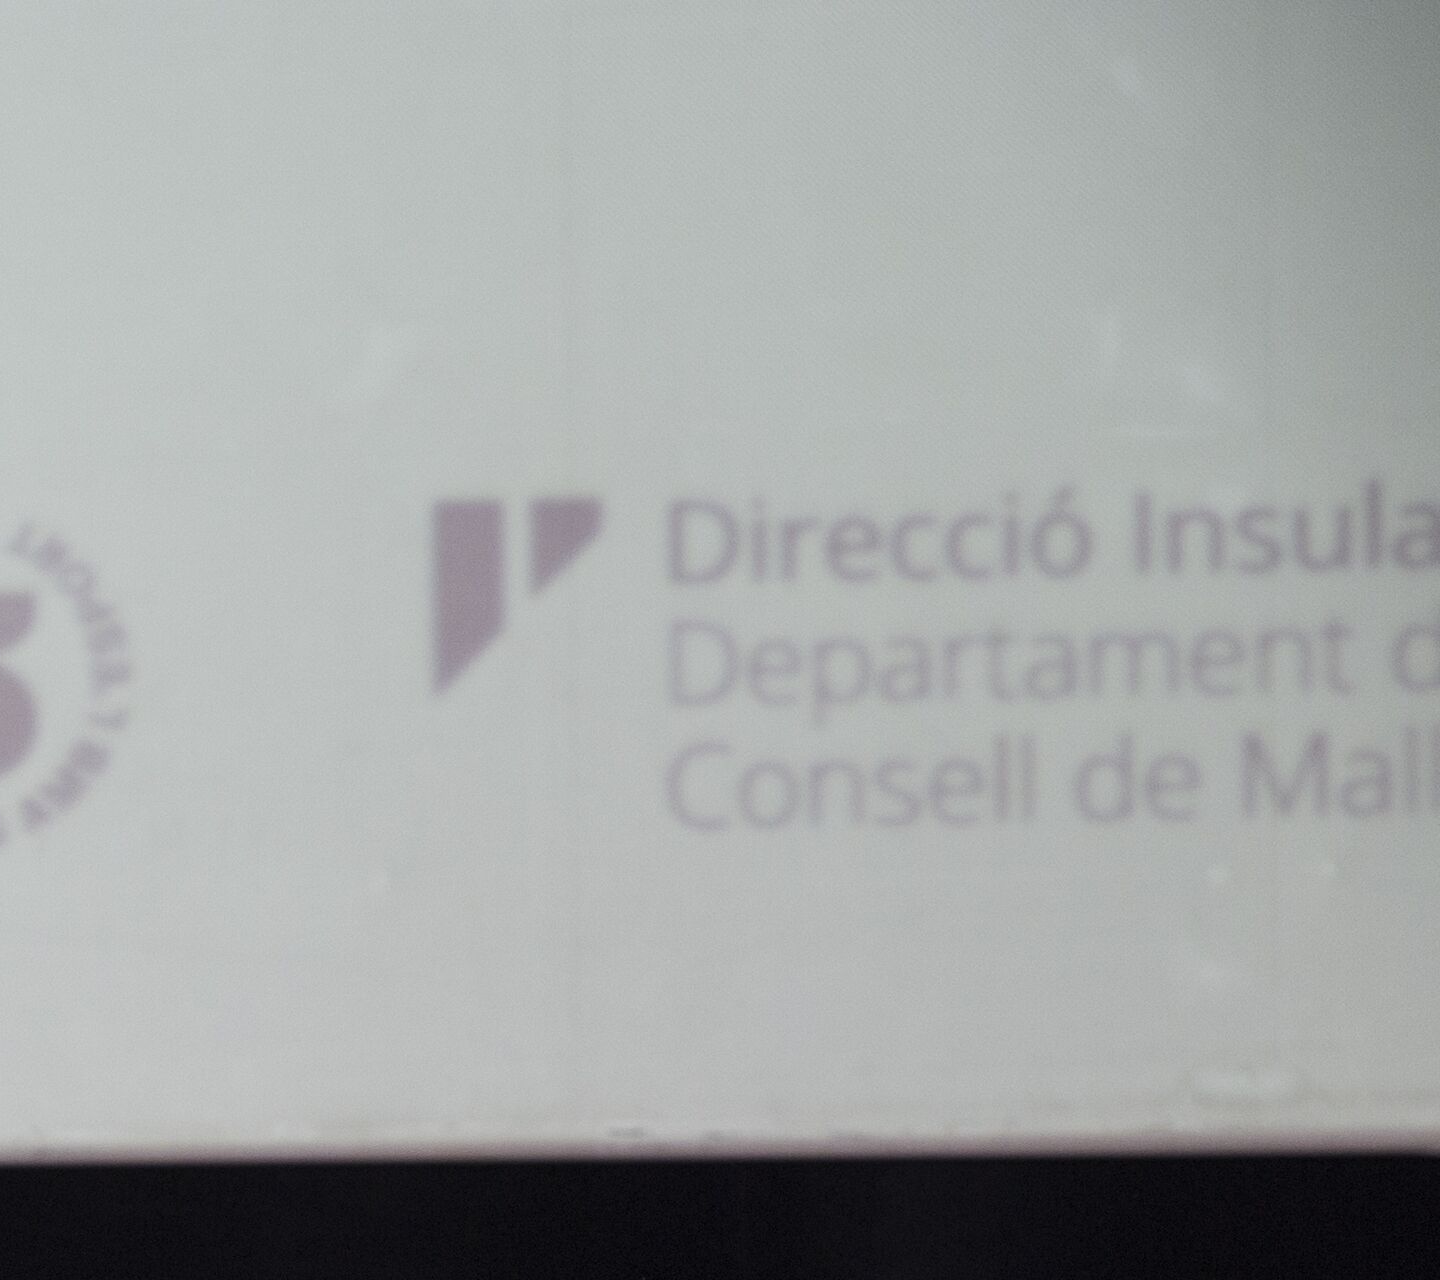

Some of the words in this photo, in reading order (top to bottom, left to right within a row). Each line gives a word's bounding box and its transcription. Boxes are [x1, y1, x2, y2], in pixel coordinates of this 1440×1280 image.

[666, 485, 1095, 586] Direcció
[1133, 476, 1440, 576] Insula
[668, 619, 1356, 730] Departament
[16, 735, 114, 831] AMB
[664, 734, 1036, 835] Consell
[1073, 734, 1201, 825] de
